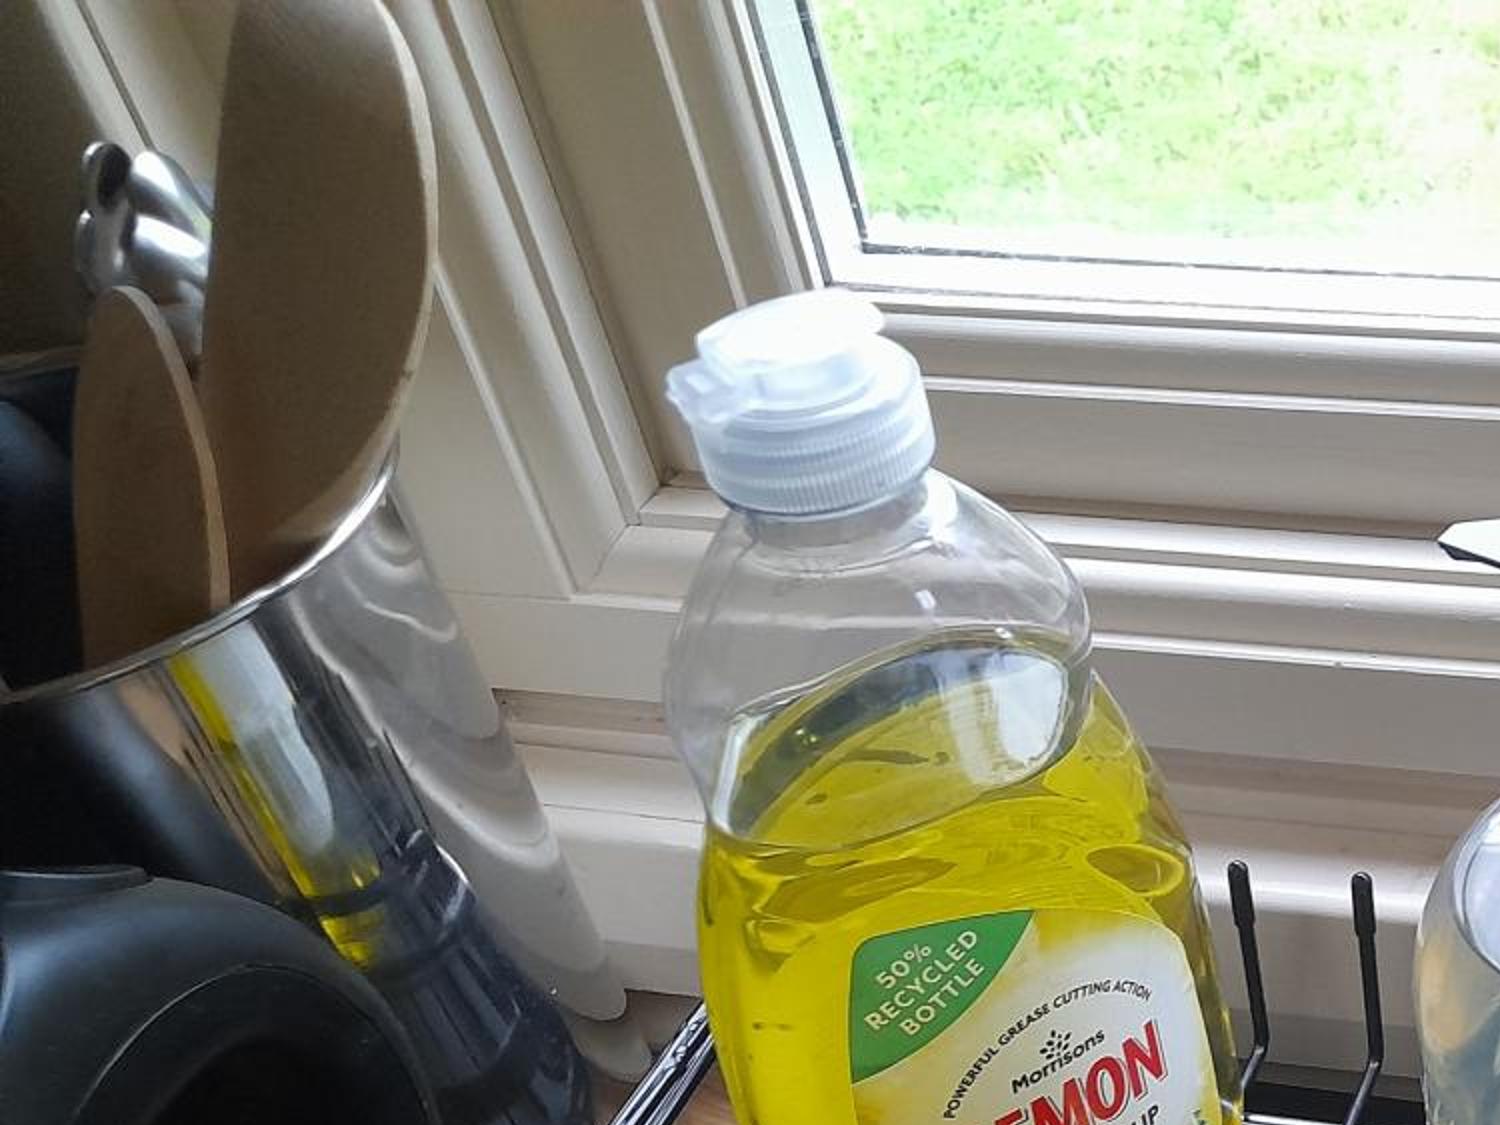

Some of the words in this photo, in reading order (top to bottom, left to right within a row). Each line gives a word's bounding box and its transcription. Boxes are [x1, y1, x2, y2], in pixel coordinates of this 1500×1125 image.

[864, 931, 977, 1030] RECYCLED
[876, 944, 932, 988] 50%
[899, 959, 985, 1035] BOTTLE
[943, 1045, 1000, 1119] POWERFUL
[997, 1003, 1051, 1046] GREASE
[1053, 980, 1111, 1008] CUTTING
[1111, 980, 1151, 1001] ACTION
[1011, 1030, 1105, 1094] Morrisons
